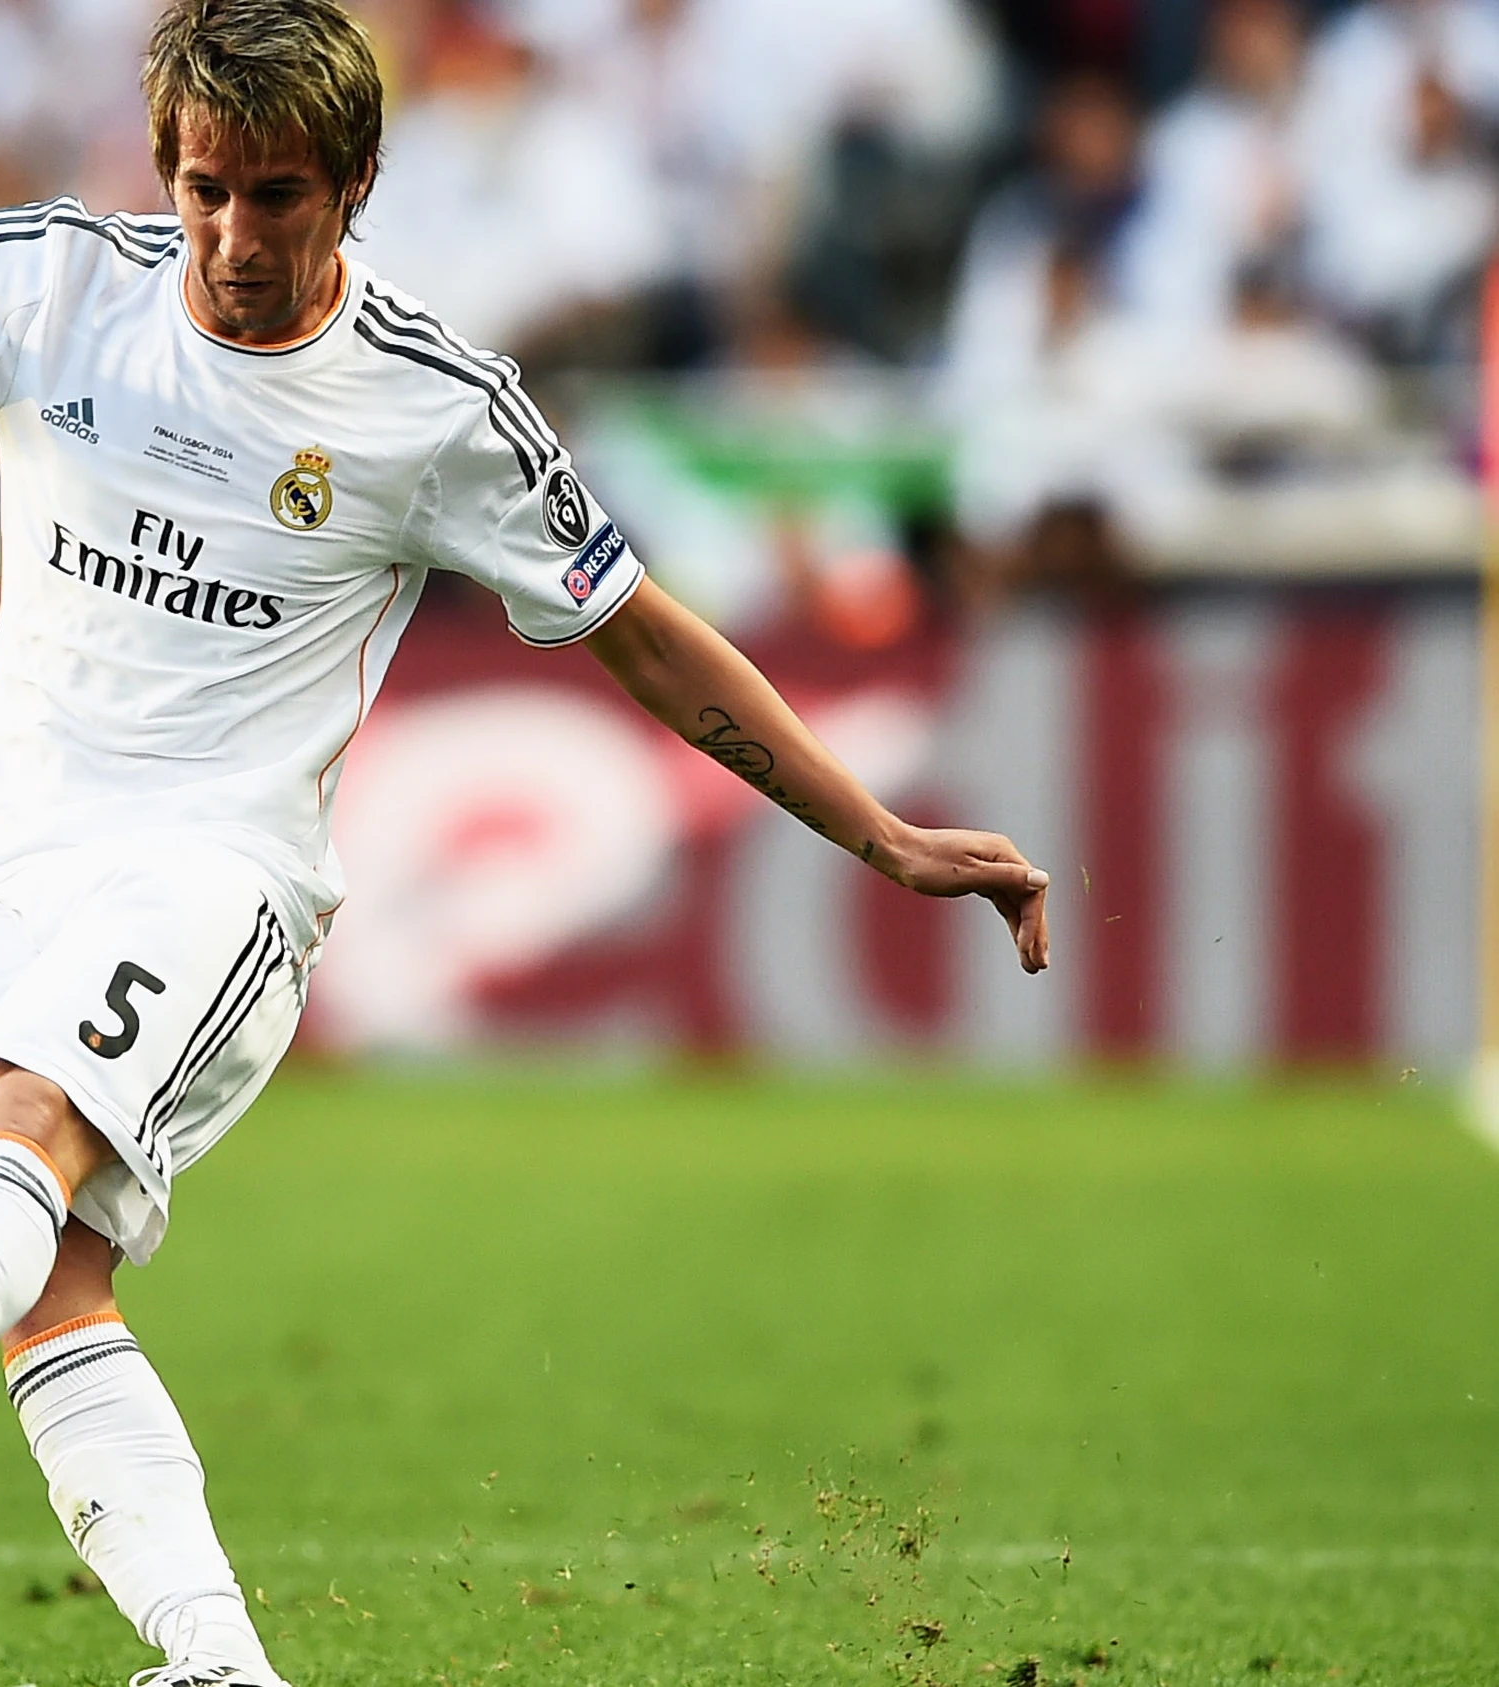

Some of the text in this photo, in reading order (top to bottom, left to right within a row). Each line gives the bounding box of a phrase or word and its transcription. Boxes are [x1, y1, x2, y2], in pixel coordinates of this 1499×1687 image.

[40, 406, 100, 445] adidas
[153, 425, 178, 442] FINAL
[179, 435, 212, 452] LISBON
[212, 446, 233, 460] 2014
[130, 509, 204, 571] Fly
[48, 520, 285, 630] Emirates
[79, 961, 166, 1059] 5
